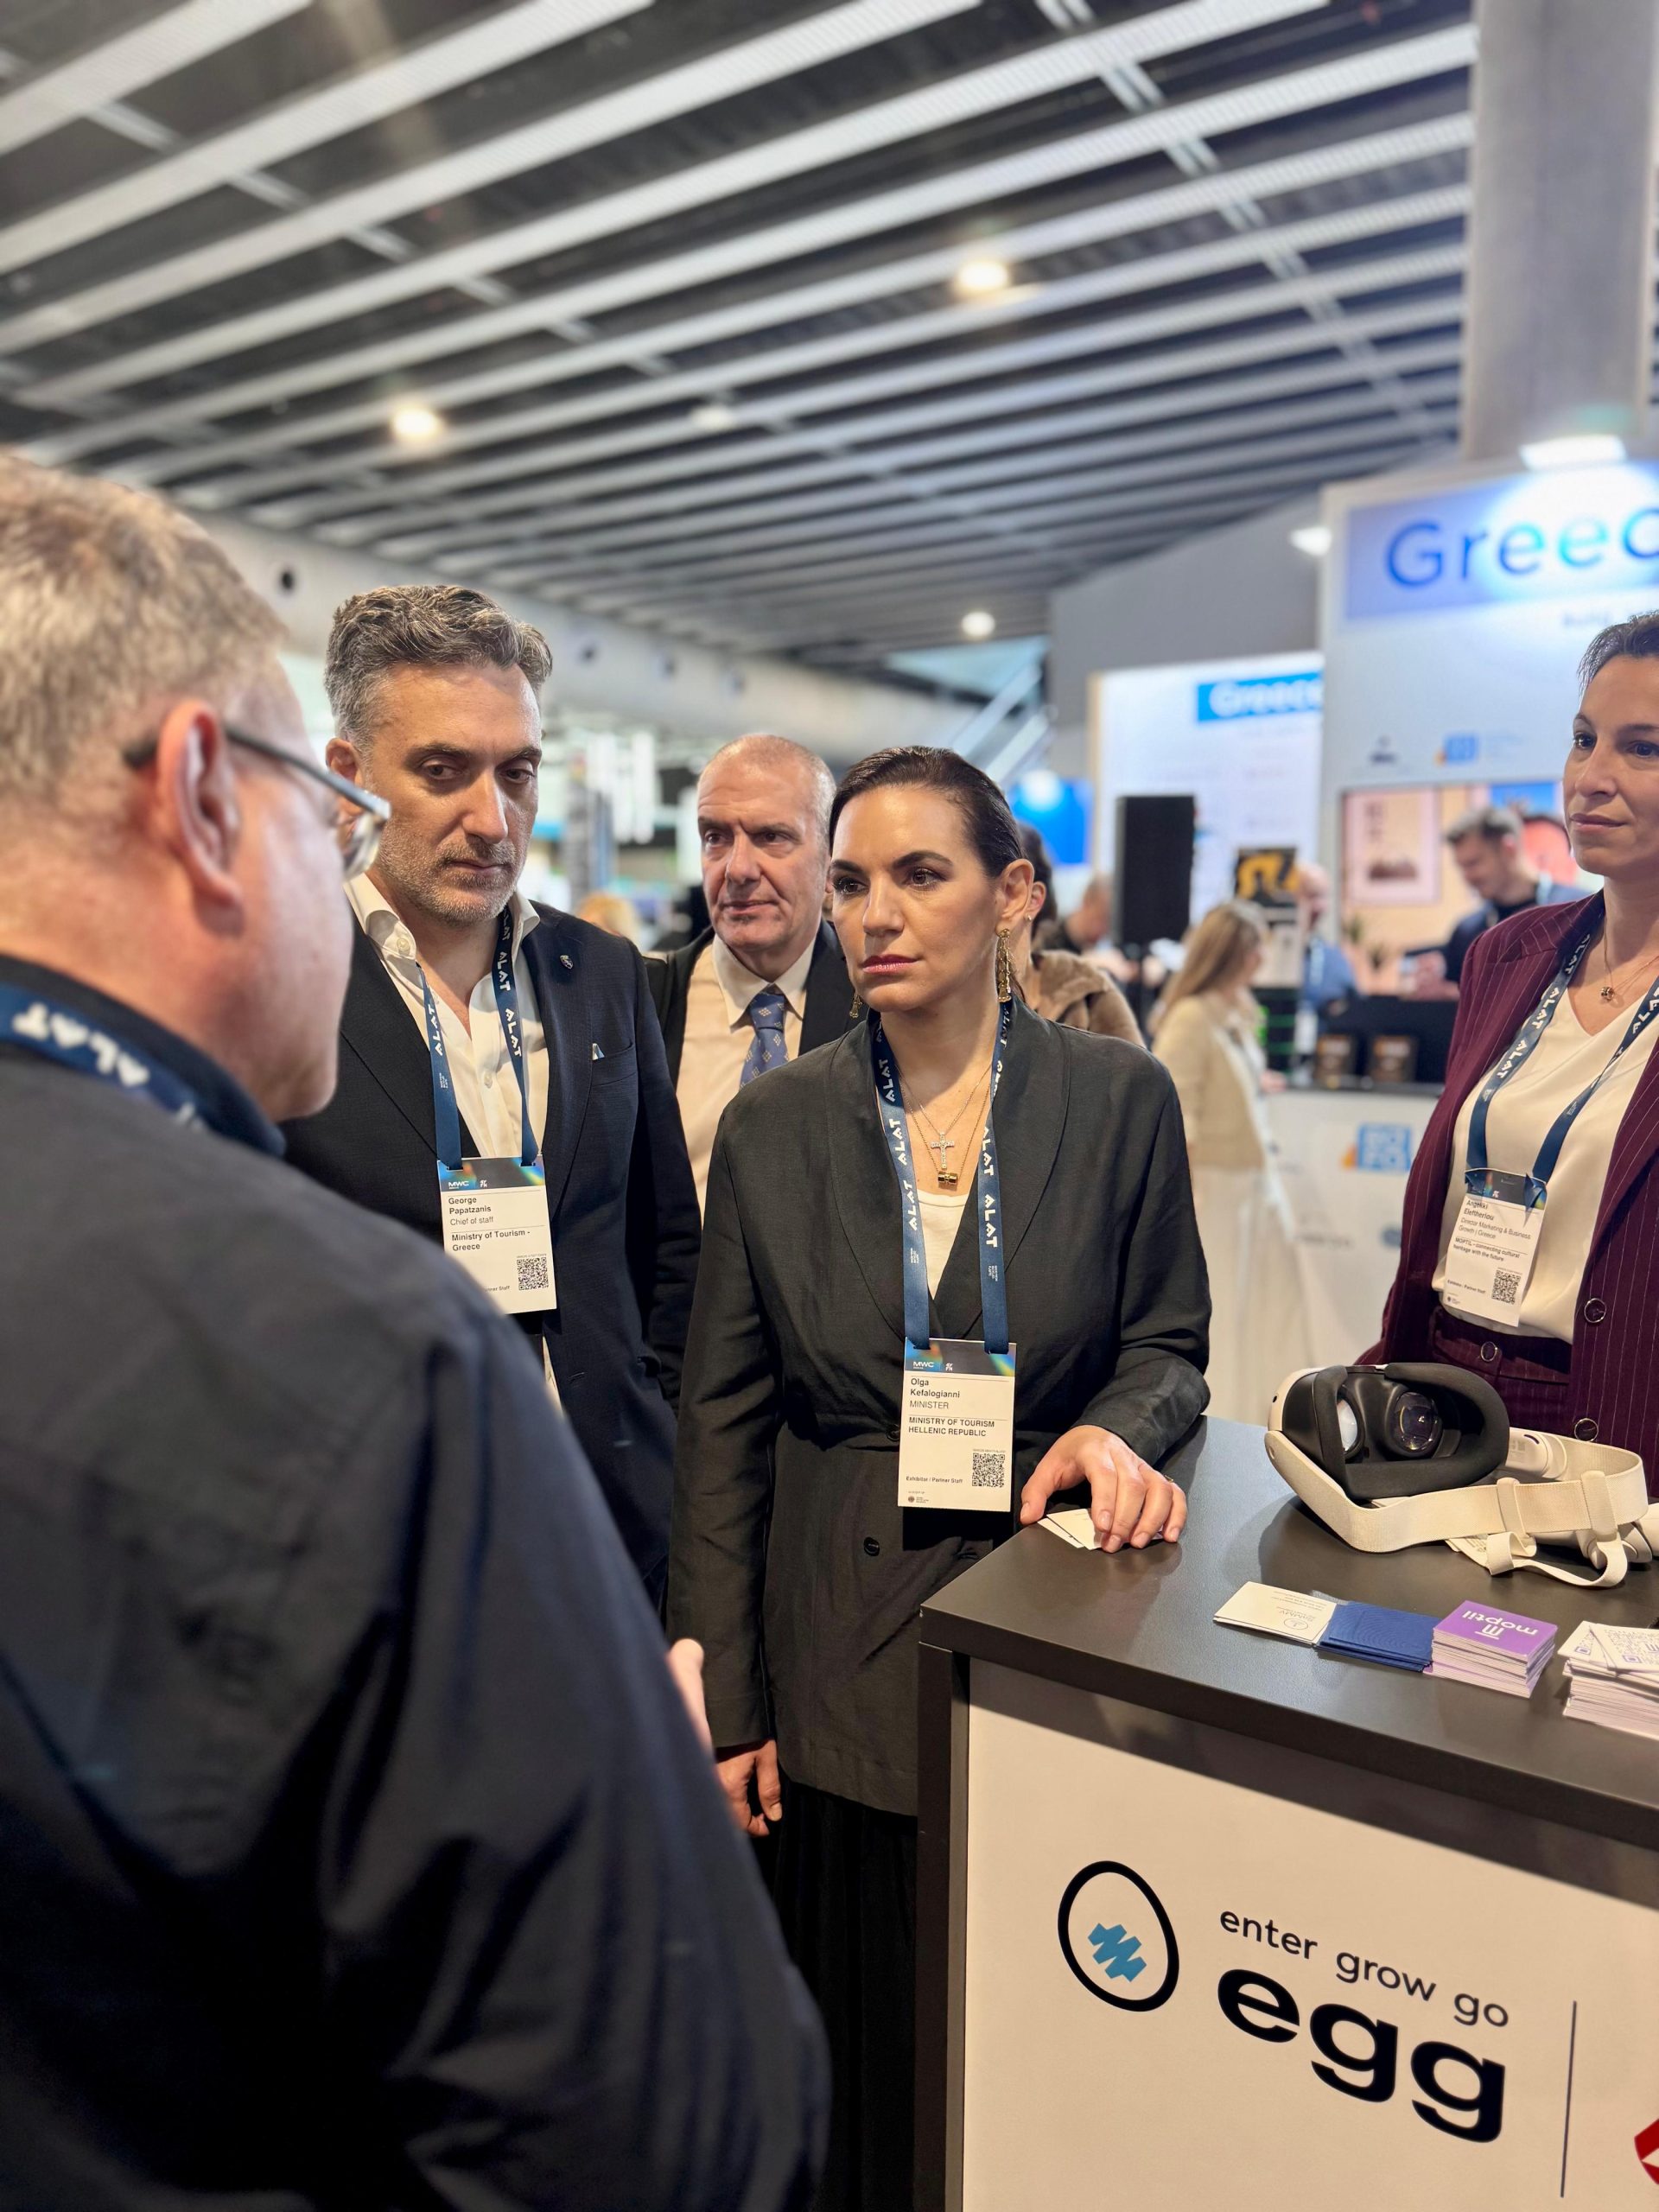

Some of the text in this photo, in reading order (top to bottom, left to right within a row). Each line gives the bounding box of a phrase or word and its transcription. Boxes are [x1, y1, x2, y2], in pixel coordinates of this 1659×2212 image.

[498, 951, 511, 991] ALAT
[1531, 987, 1560, 1030] ALAT
[1632, 987, 1659, 1034] ALA
[427, 1003, 444, 1057] ALAT
[505, 1008, 522, 1058] ALAT
[1497, 1039, 1528, 1080] ALAT
[879, 1058, 897, 1103] ALAT
[888, 1118, 908, 1166] ALAT
[982, 1126, 995, 1176] ALAT
[449, 1205, 492, 1215] Papatzanis
[902, 1179, 918, 1231] ALAT
[984, 1194, 998, 1248] ALAT
[452, 1233, 482, 1242] Ministry
[494, 1230, 525, 1238] Tourism
[1453, 1243, 1471, 1253] heritage
[1458, 1224, 1475, 1233] Growth
[1478, 1230, 1497, 1239] Greece
[1475, 1243, 1502, 1255] connecting
[1501, 1249, 1520, 1258] cultural
[1478, 1222, 1503, 1233] Marketing
[1508, 1229, 1531, 1240] Business
[910, 1389, 960, 1398] Kefalogianni
[911, 1378, 929, 1387] Olga
[909, 1416, 944, 1425] MINISTRY
[910, 1400, 949, 1409] MINISTER
[948, 1428, 987, 1437] REPUBLIC
[1463, 1609, 1540, 1637] moptil
[1219, 1908, 1510, 2028] enter grow go
[1216, 1967, 1506, 2145] egg
